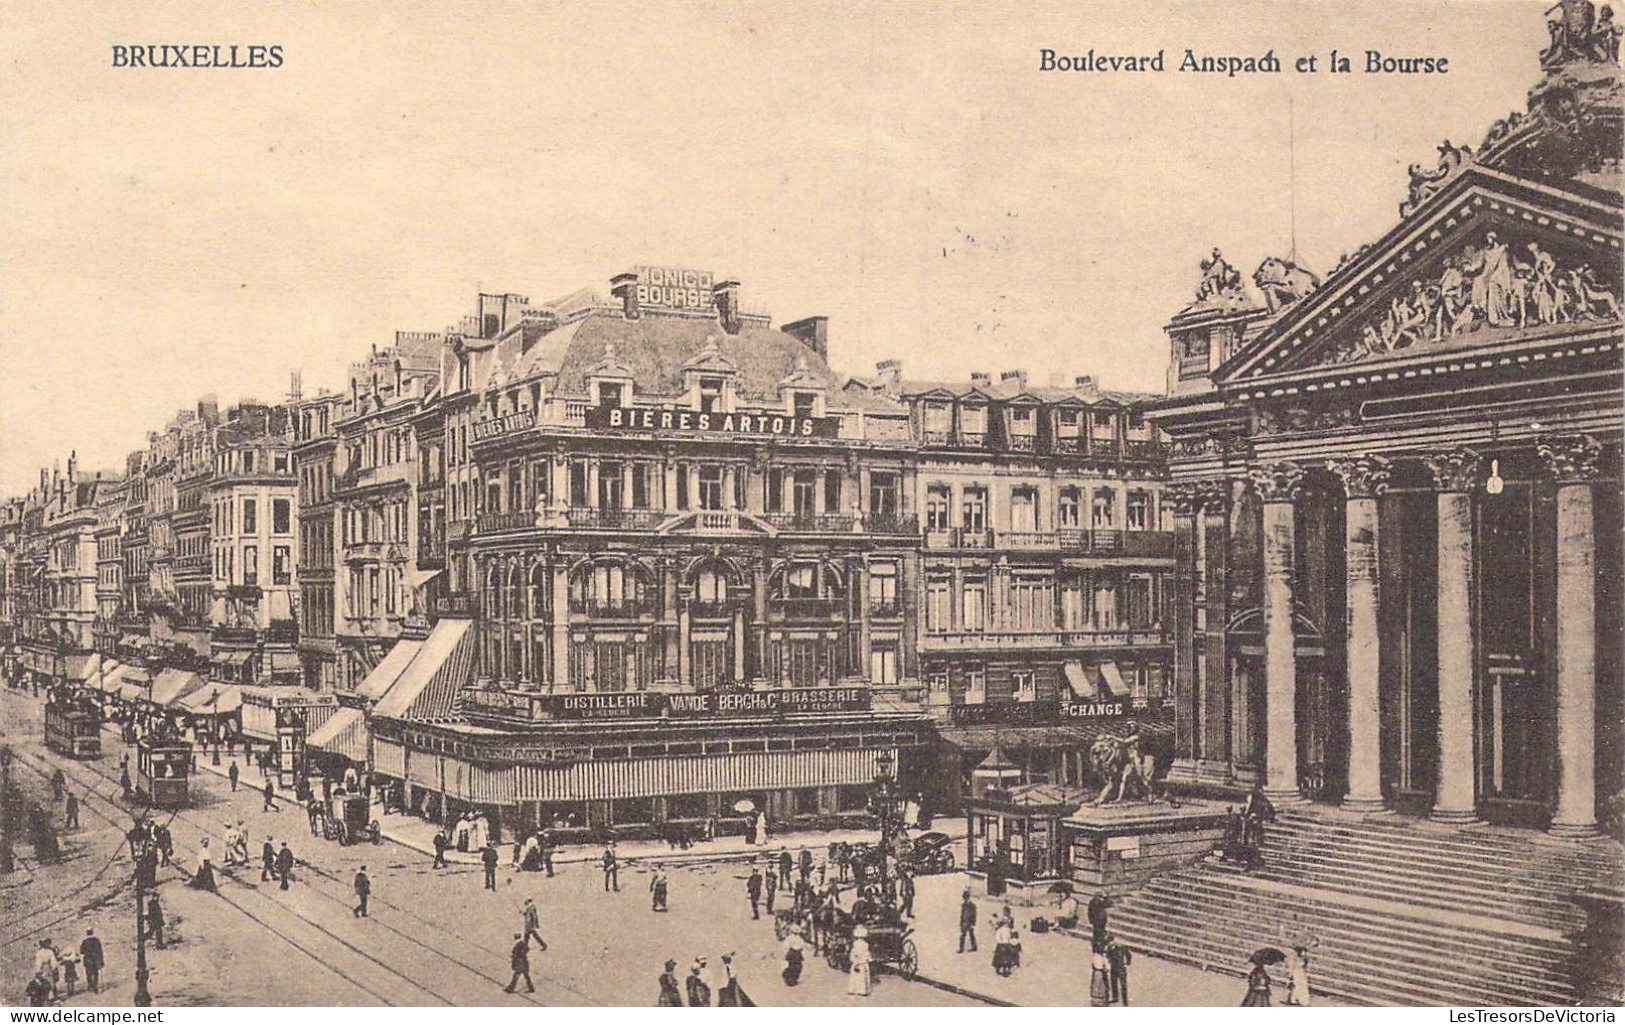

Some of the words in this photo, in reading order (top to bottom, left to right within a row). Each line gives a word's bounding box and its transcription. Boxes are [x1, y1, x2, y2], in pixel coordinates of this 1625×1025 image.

[636, 285, 712, 307] BOURSE
[609, 409, 710, 430] BIERES
[723, 416, 813, 435] ARTOIS
[564, 695, 648, 709] DISTILLERIE
[669, 695, 709, 711] VANDE
[782, 690, 859, 704] BRASSERIE
[1069, 703, 1123, 717] CHANGE
